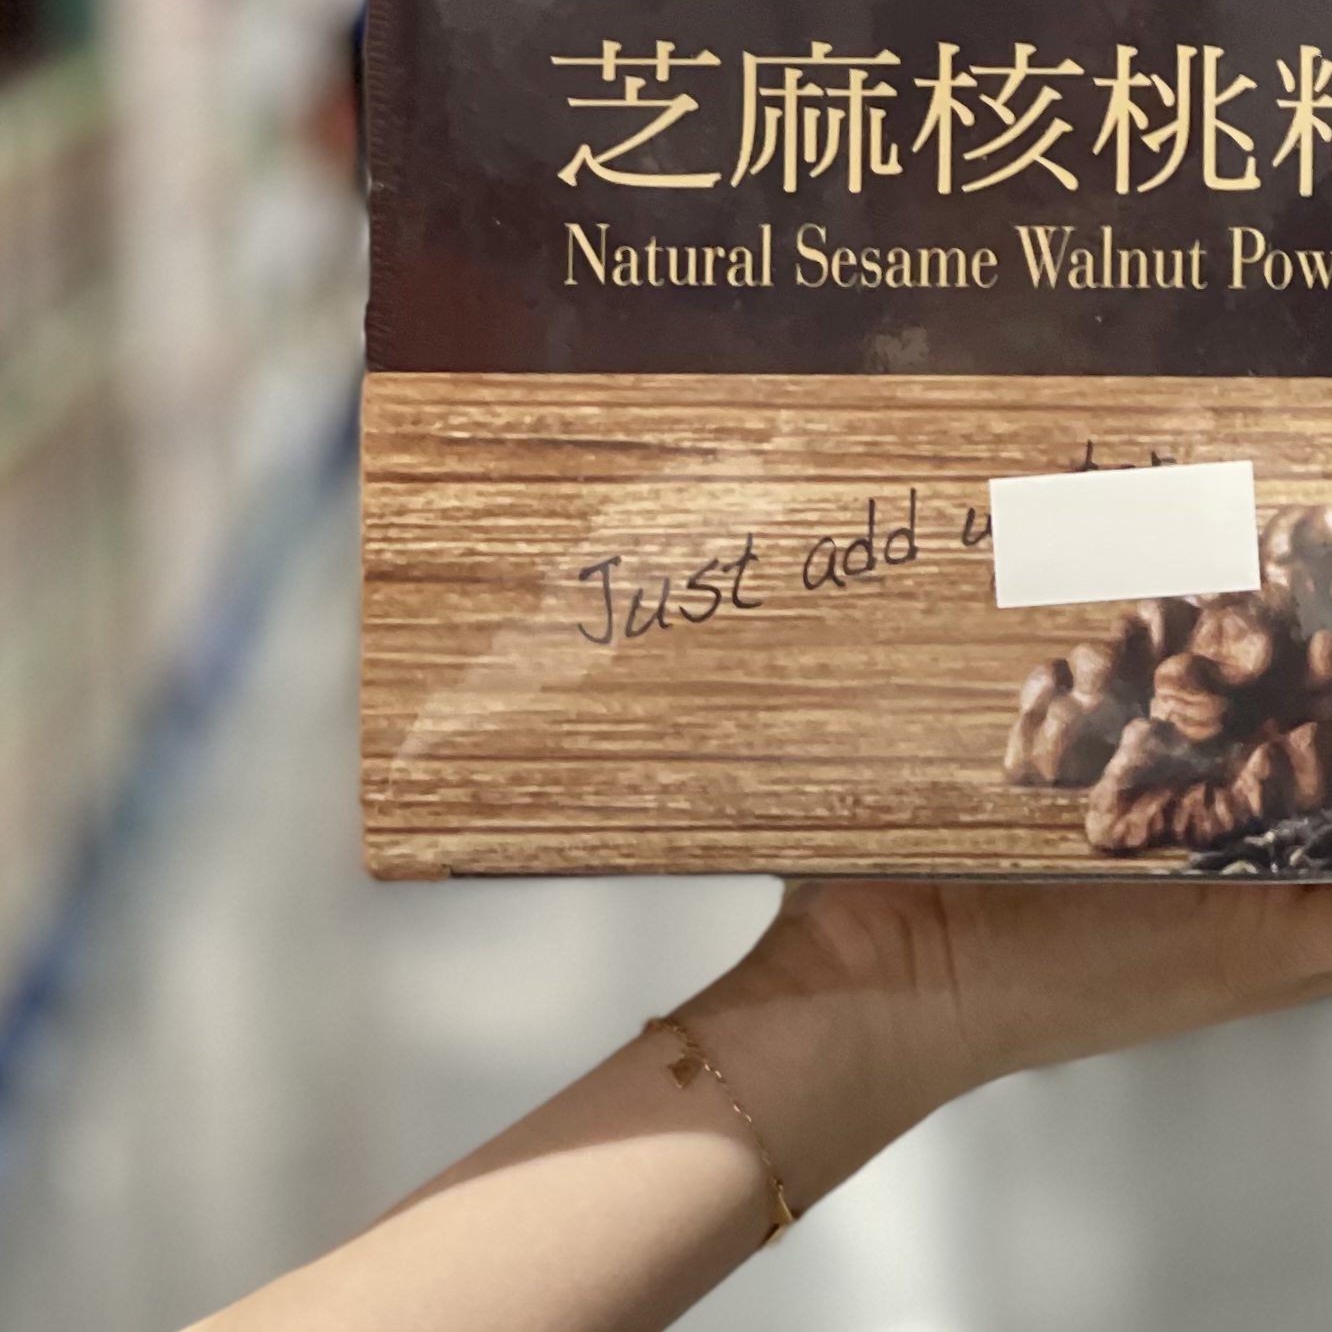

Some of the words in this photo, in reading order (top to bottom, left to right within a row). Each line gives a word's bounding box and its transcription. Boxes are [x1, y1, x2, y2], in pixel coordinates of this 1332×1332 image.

[564, 222, 775, 288] Natural
[795, 222, 999, 290] Sesame
[1014, 224, 1209, 291] Walnut
[577, 532, 763, 645] Just
[802, 487, 918, 590] add
